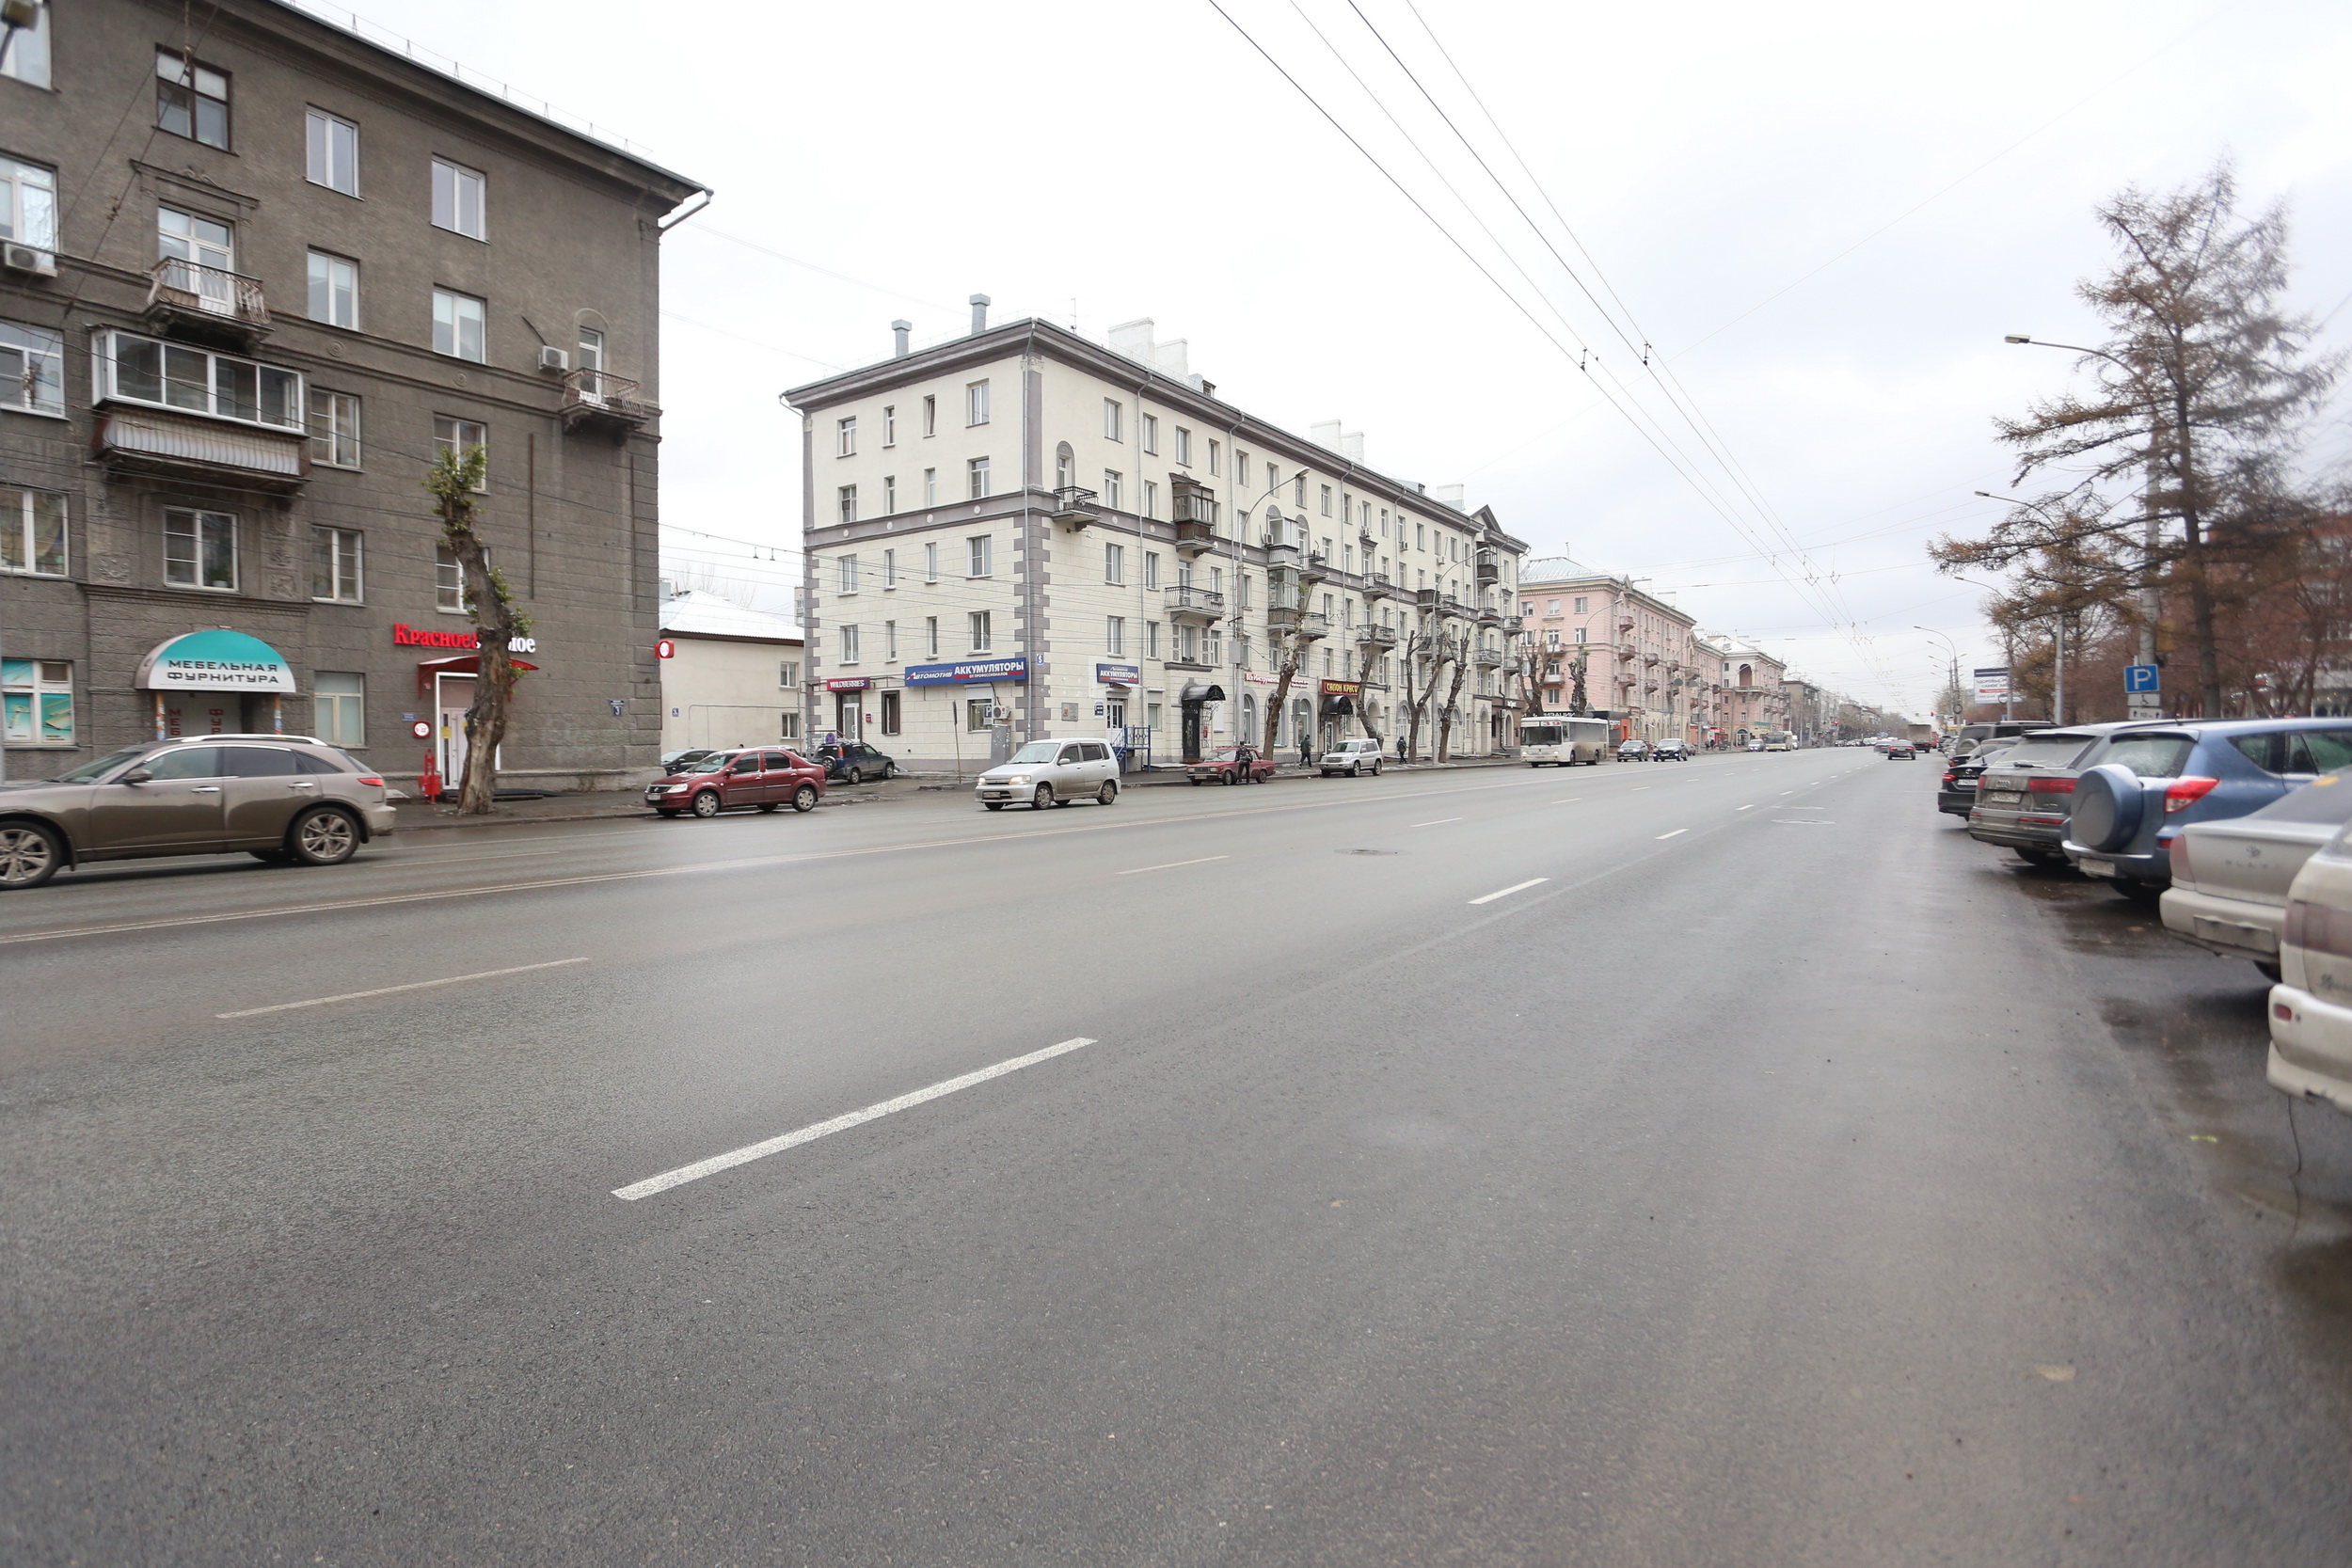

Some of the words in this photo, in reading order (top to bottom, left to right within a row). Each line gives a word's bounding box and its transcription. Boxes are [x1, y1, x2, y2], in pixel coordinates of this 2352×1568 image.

[1037, 654, 1043, 663] 5
[168, 660, 278, 673] МЕБЕЛЬНАЯ
[954, 661, 1024, 675] АККУМУЛЯТОРЫ
[167, 672, 279, 684] ФУРНИТУРА
[1100, 670, 1138, 678] АККУМУЛЯТОРЫ
[2134, 669, 2152, 689] P
[830, 679, 865, 689] WILDBERRIES
[1327, 683, 1342, 692] САЛОН
